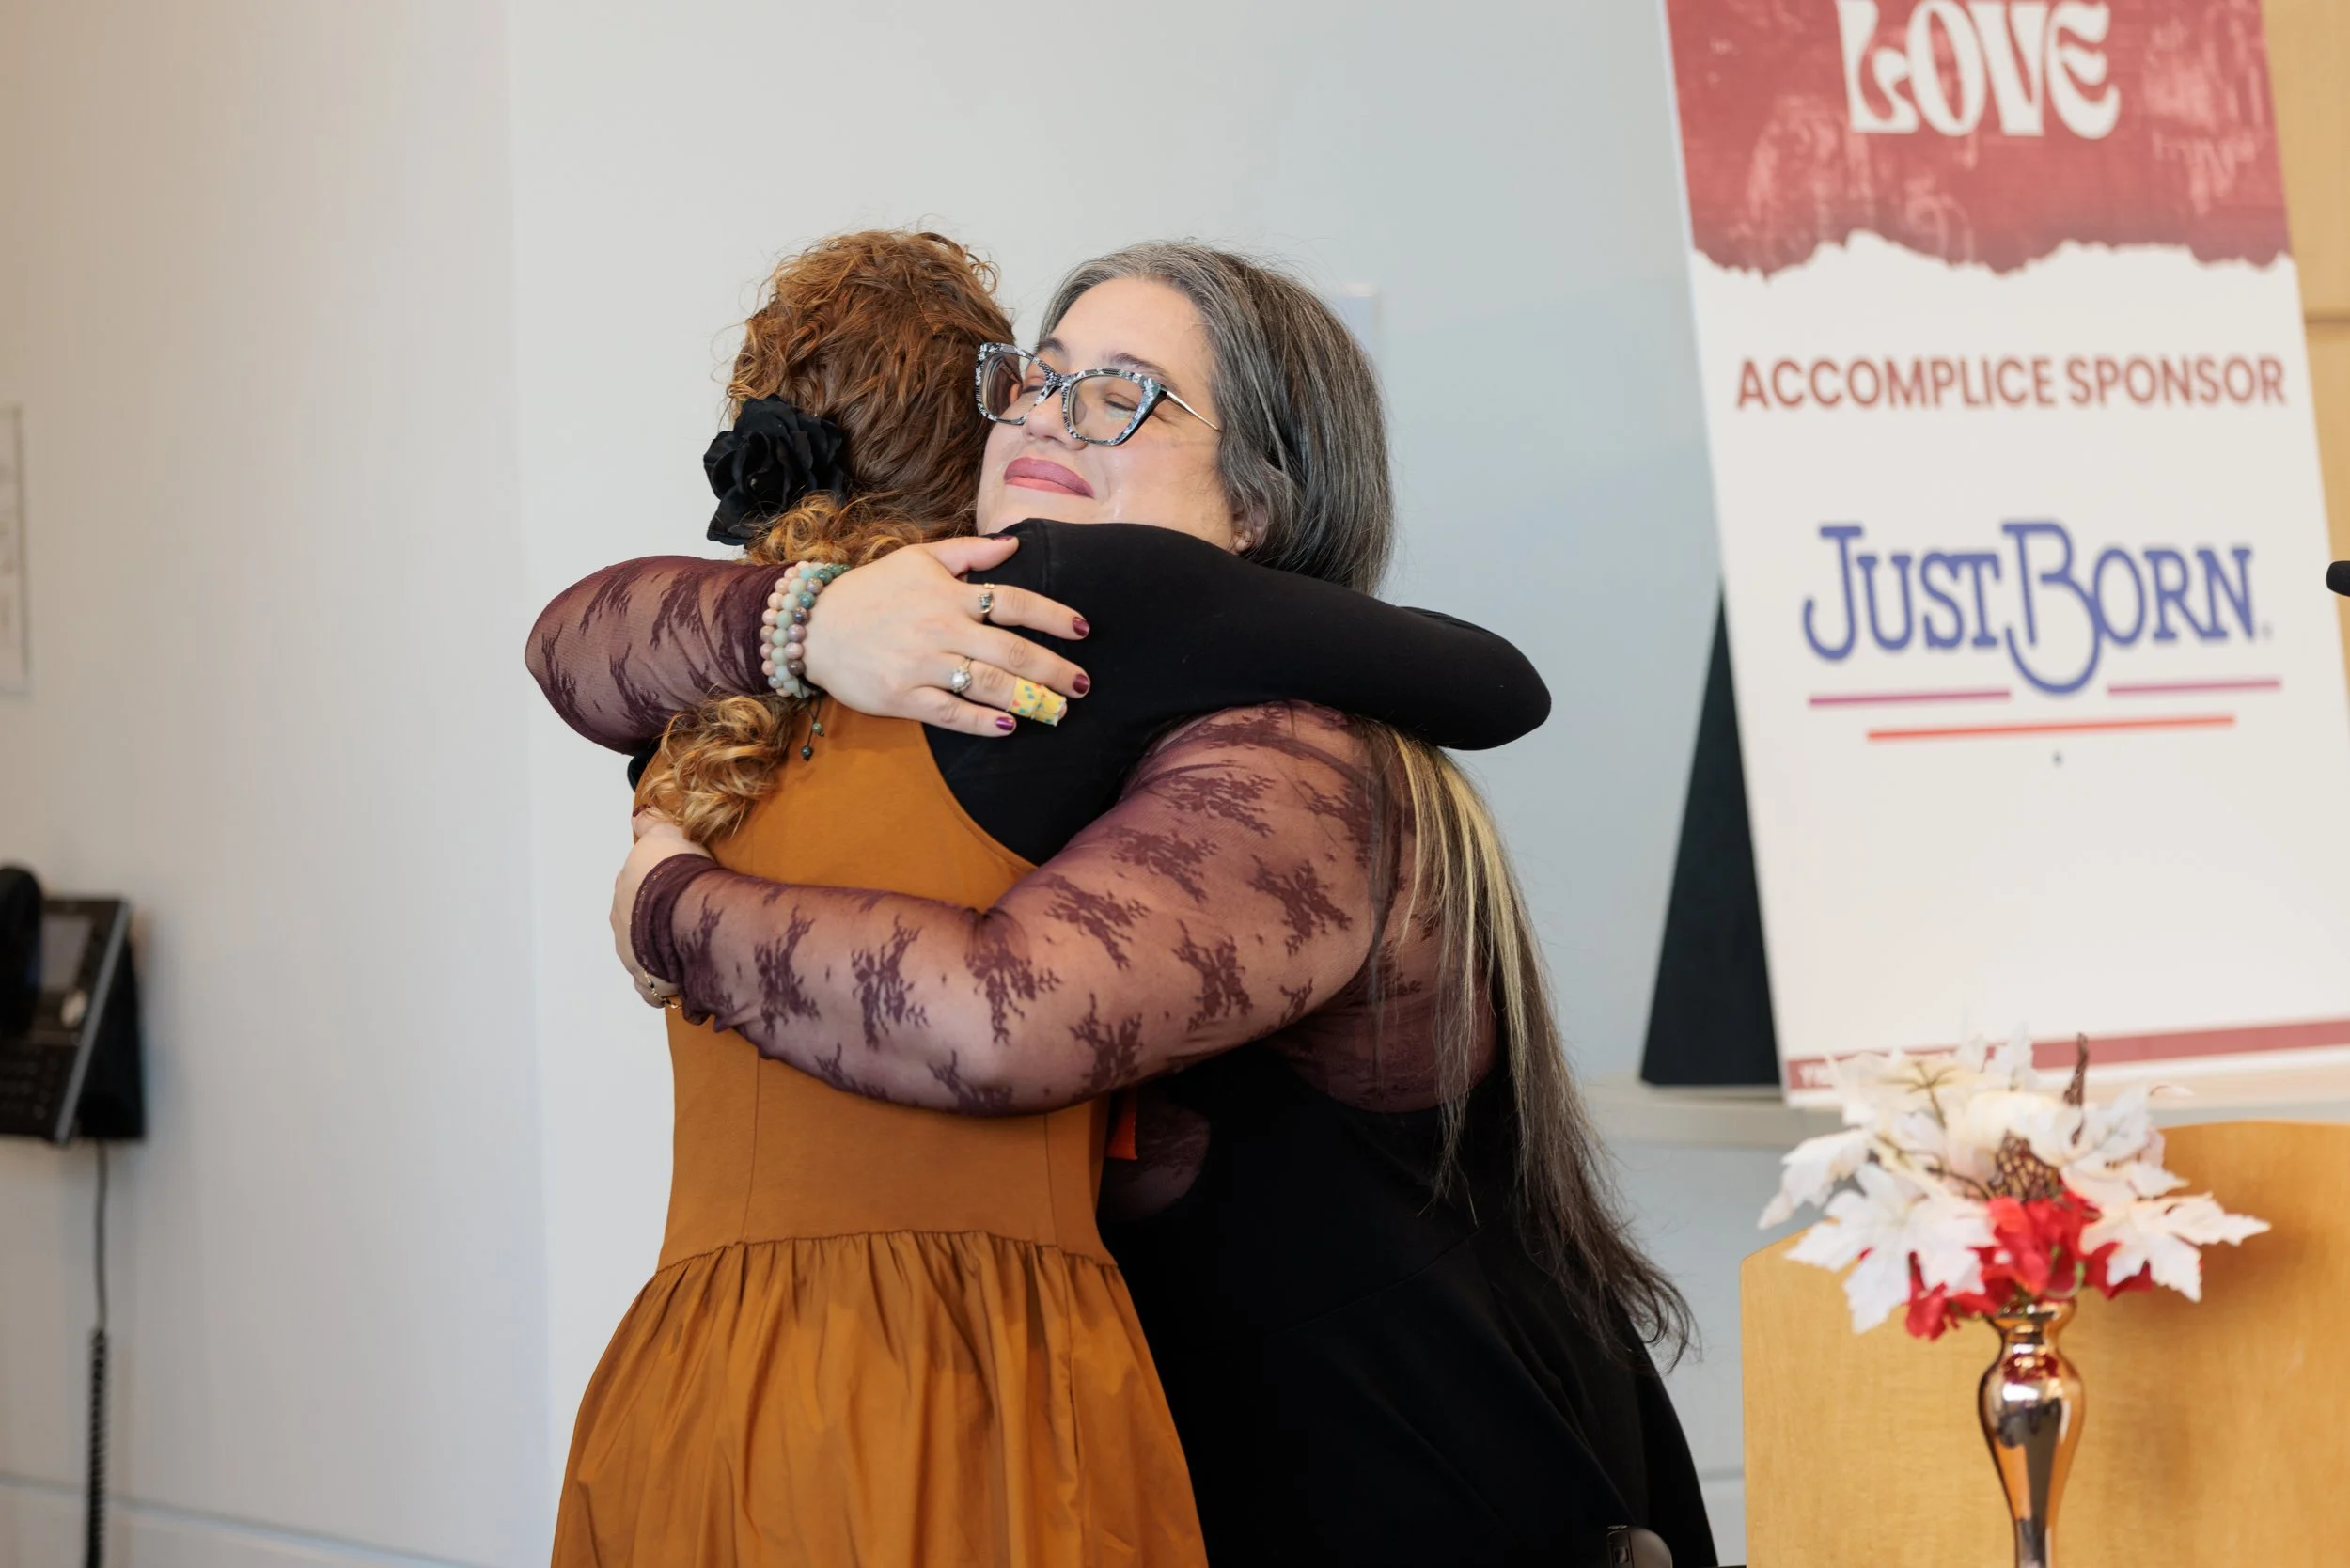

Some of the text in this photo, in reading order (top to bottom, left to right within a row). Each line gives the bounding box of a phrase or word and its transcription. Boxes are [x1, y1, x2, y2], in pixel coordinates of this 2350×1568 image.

[1837, 0, 2122, 139] LOVE
[1735, 355, 2287, 409] ACCOMPLICE SPONSOR
